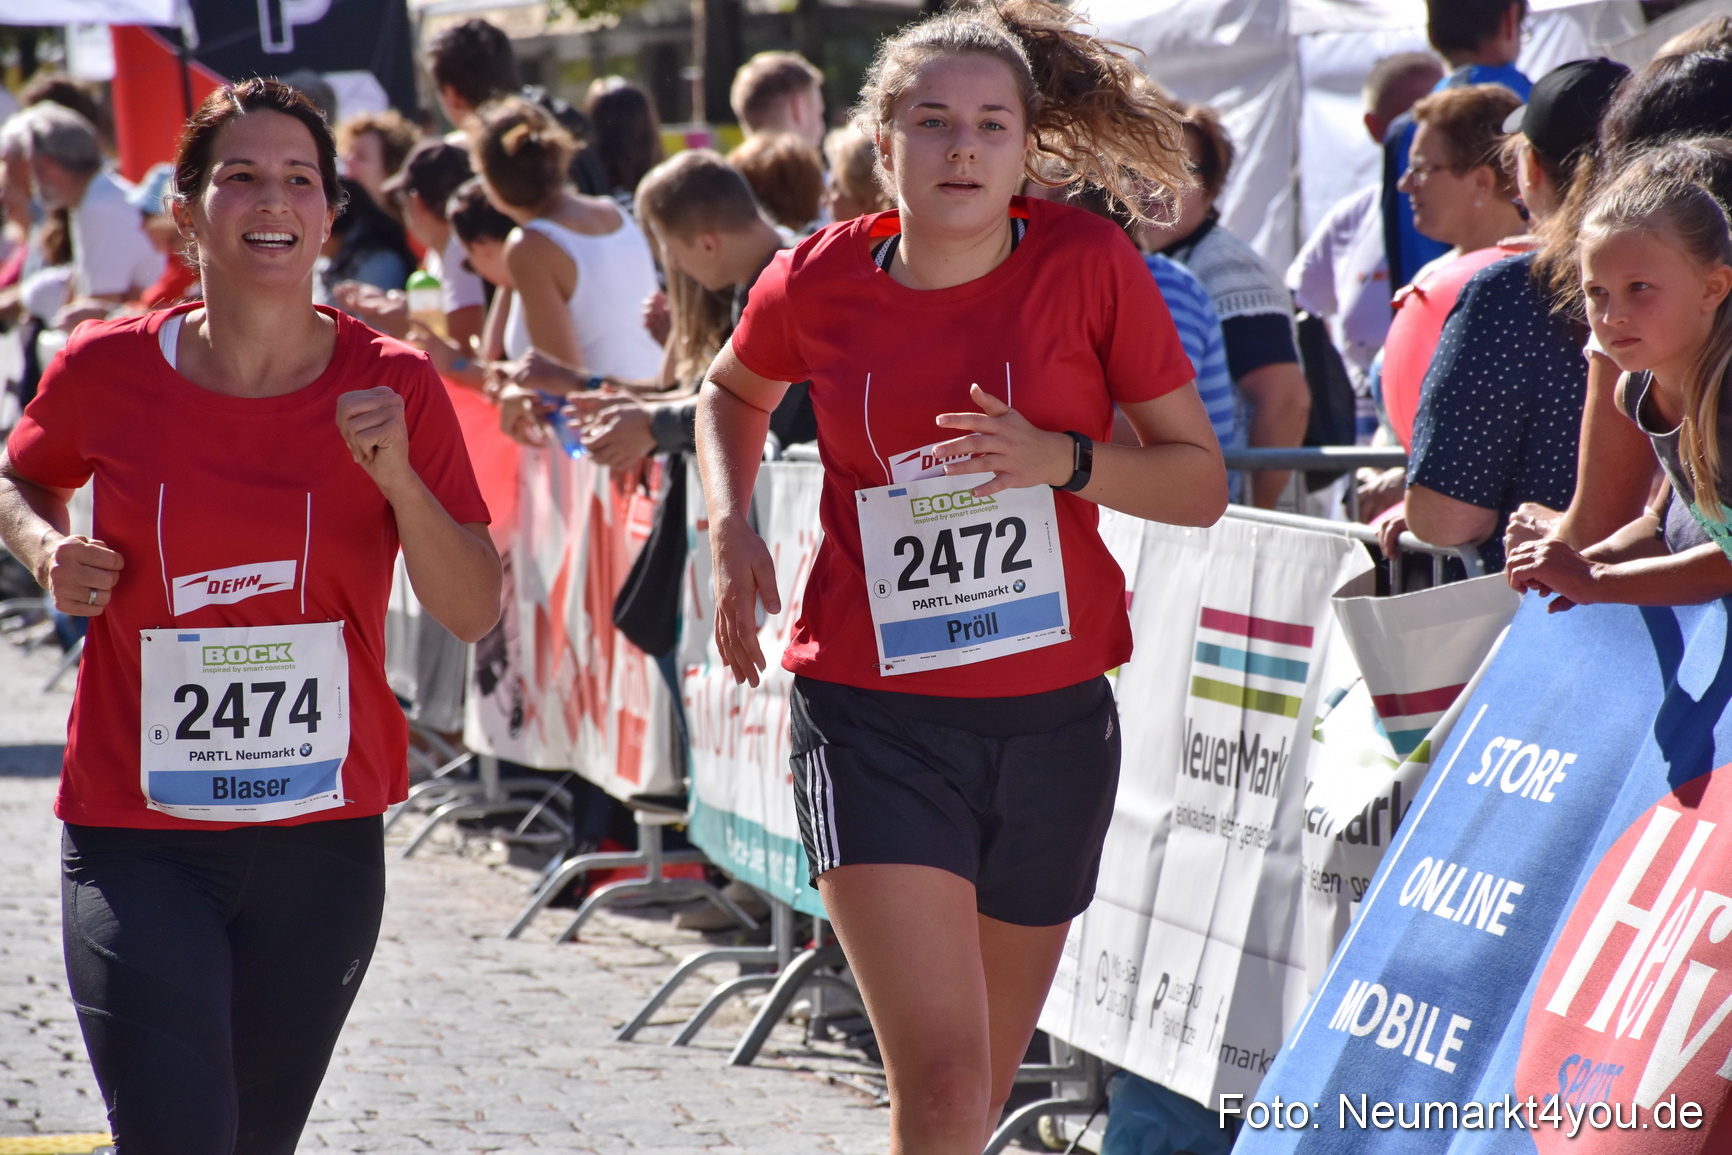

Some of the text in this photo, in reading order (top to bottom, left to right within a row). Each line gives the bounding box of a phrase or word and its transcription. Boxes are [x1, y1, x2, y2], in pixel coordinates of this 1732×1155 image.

[913, 504, 999, 525] inspired by smart concepts
[893, 516, 1033, 592] 2472
[206, 573, 262, 595] DEHN
[912, 584, 1010, 611] PARTL Neumarkt
[946, 611, 999, 644] Pröll
[202, 642, 295, 666] BOCK
[202, 666, 231, 674] inspired
[232, 665, 242, 673] by
[264, 663, 296, 672] concepts
[173, 677, 322, 741] 2474
[189, 746, 296, 762] PARTL Neumarkt
[1467, 735, 1578, 803] STORE
[212, 775, 291, 801] Blaser
[1399, 856, 1525, 937] ONLINE
[1328, 979, 1473, 1075] MOBILE
